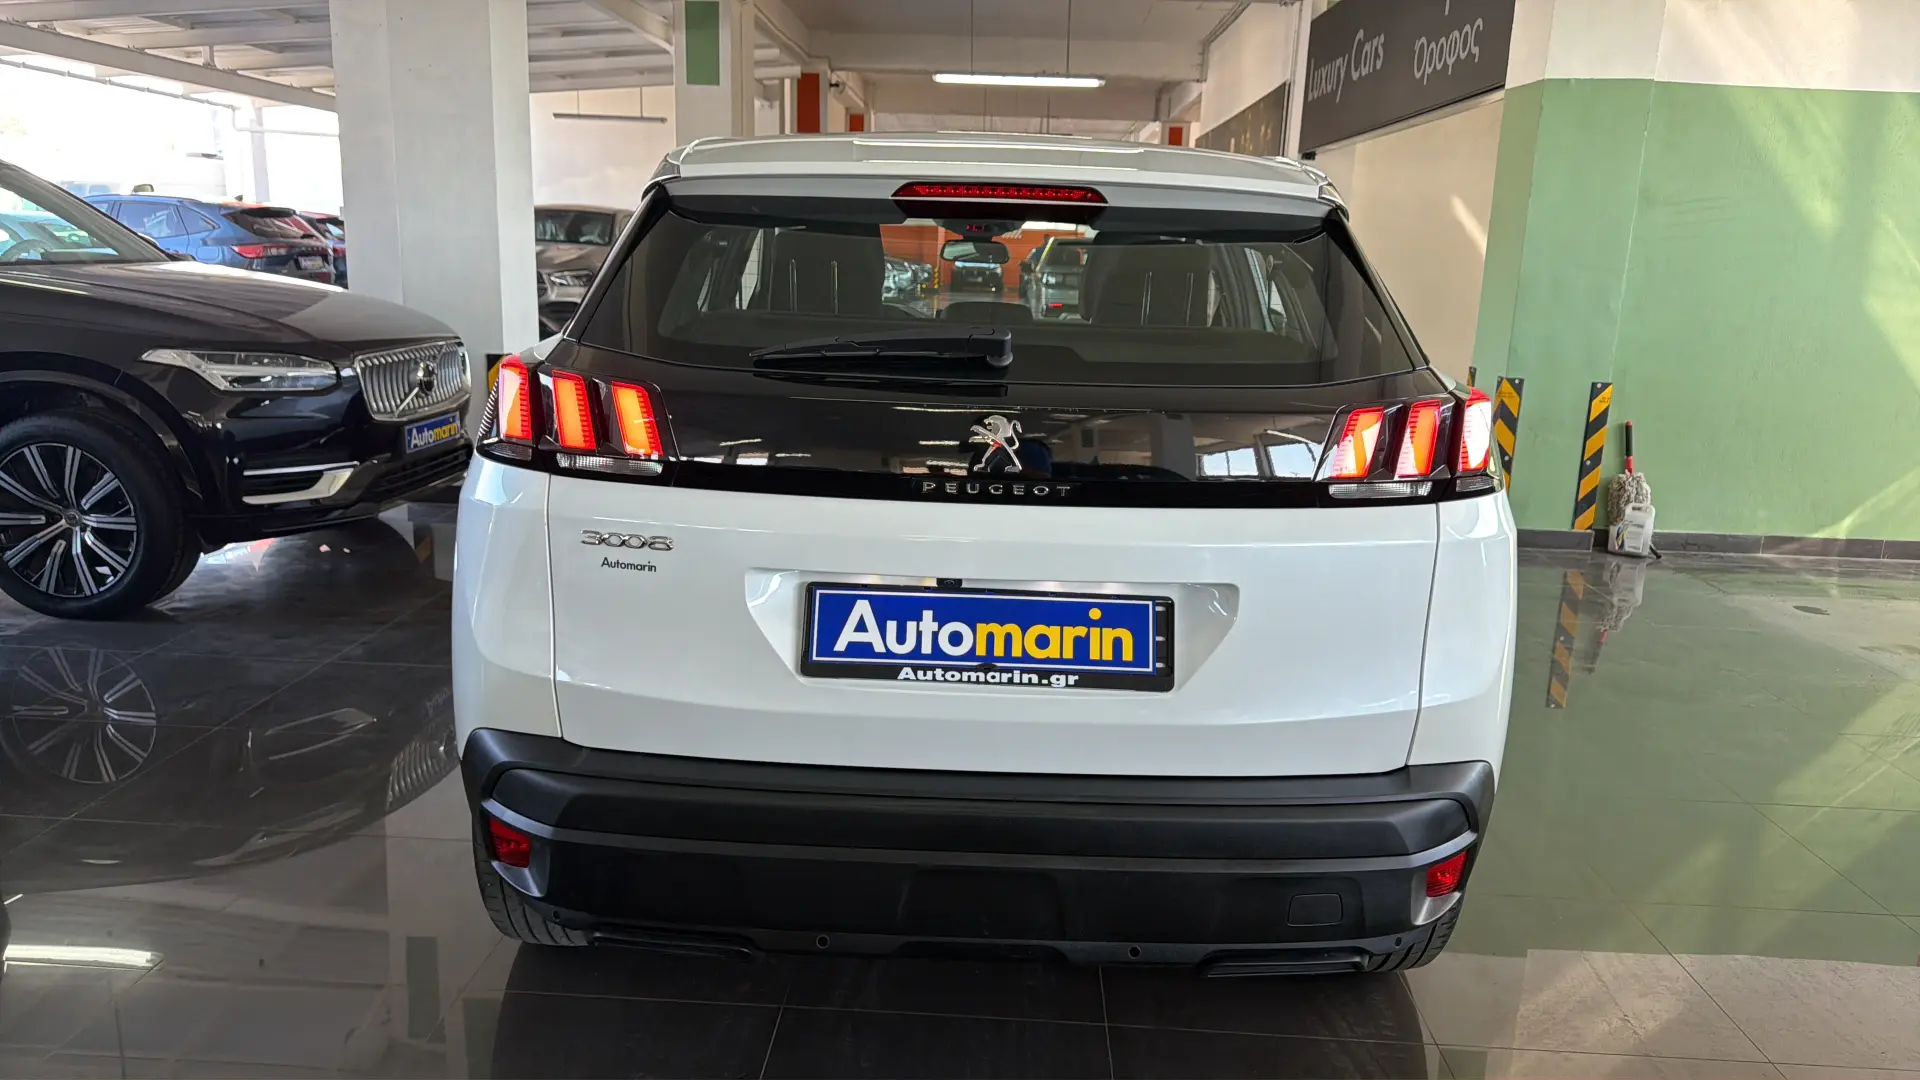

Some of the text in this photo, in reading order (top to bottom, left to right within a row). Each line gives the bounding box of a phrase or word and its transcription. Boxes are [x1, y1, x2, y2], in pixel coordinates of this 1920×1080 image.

[1308, 28, 1385, 104] Luxury Cars
[410, 417, 458, 449] Automarin
[922, 481, 1070, 497] PEUGEOT
[580, 529, 675, 551] 3008
[600, 556, 657, 573] Automarin
[832, 599, 1134, 662] Automarin
[896, 666, 1079, 688] Automarin.gr
